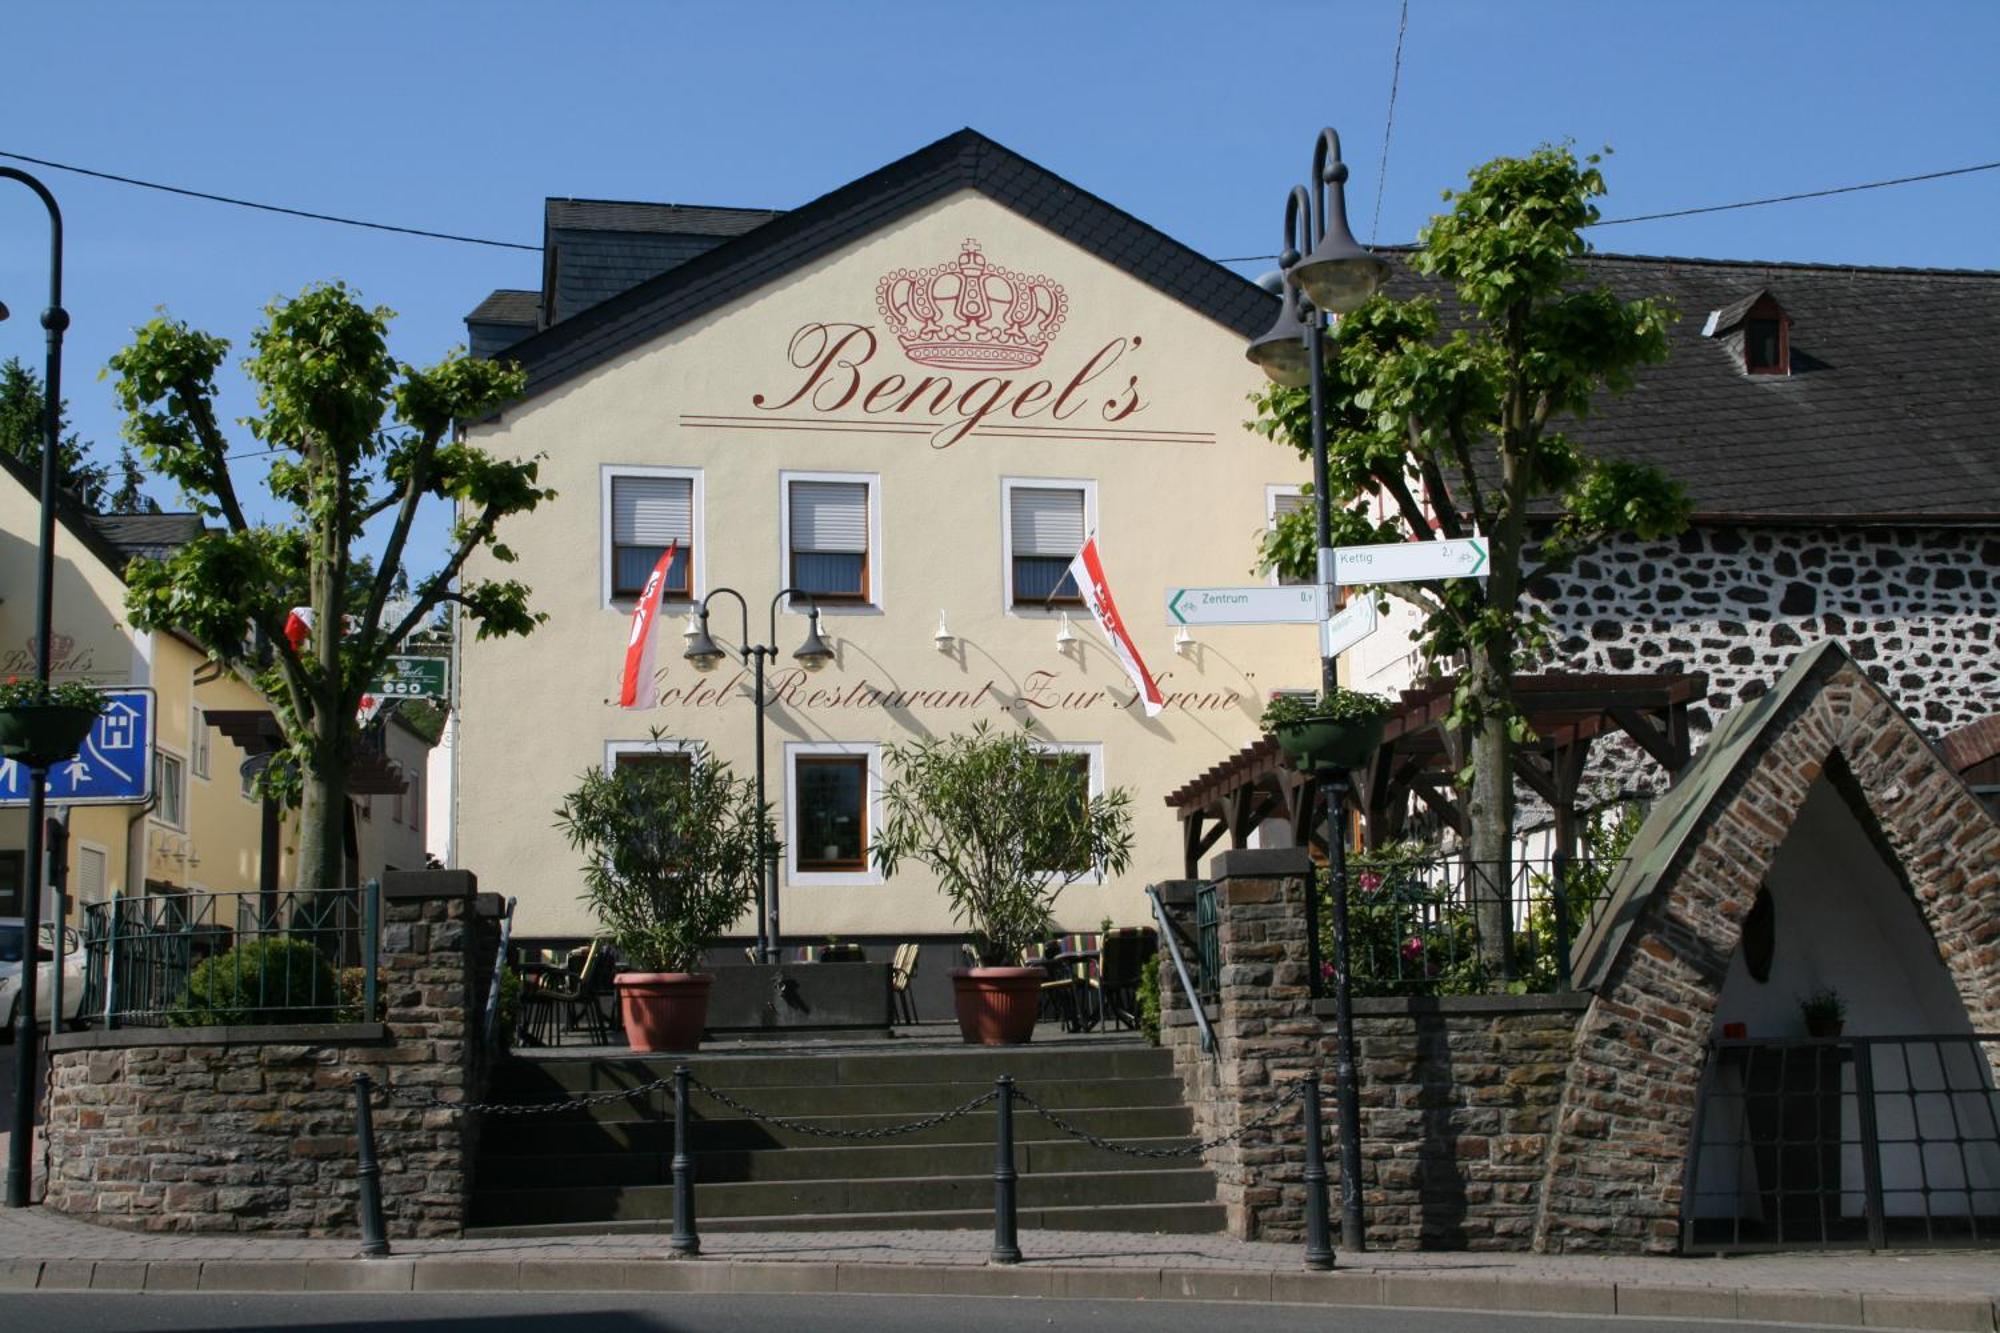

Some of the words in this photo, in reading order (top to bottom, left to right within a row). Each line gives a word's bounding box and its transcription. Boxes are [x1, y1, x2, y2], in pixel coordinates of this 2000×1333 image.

[752, 321, 1150, 450] Bengel's
[1340, 553, 1373, 565] Kettig
[1202, 592, 1249, 604] Zentrum
